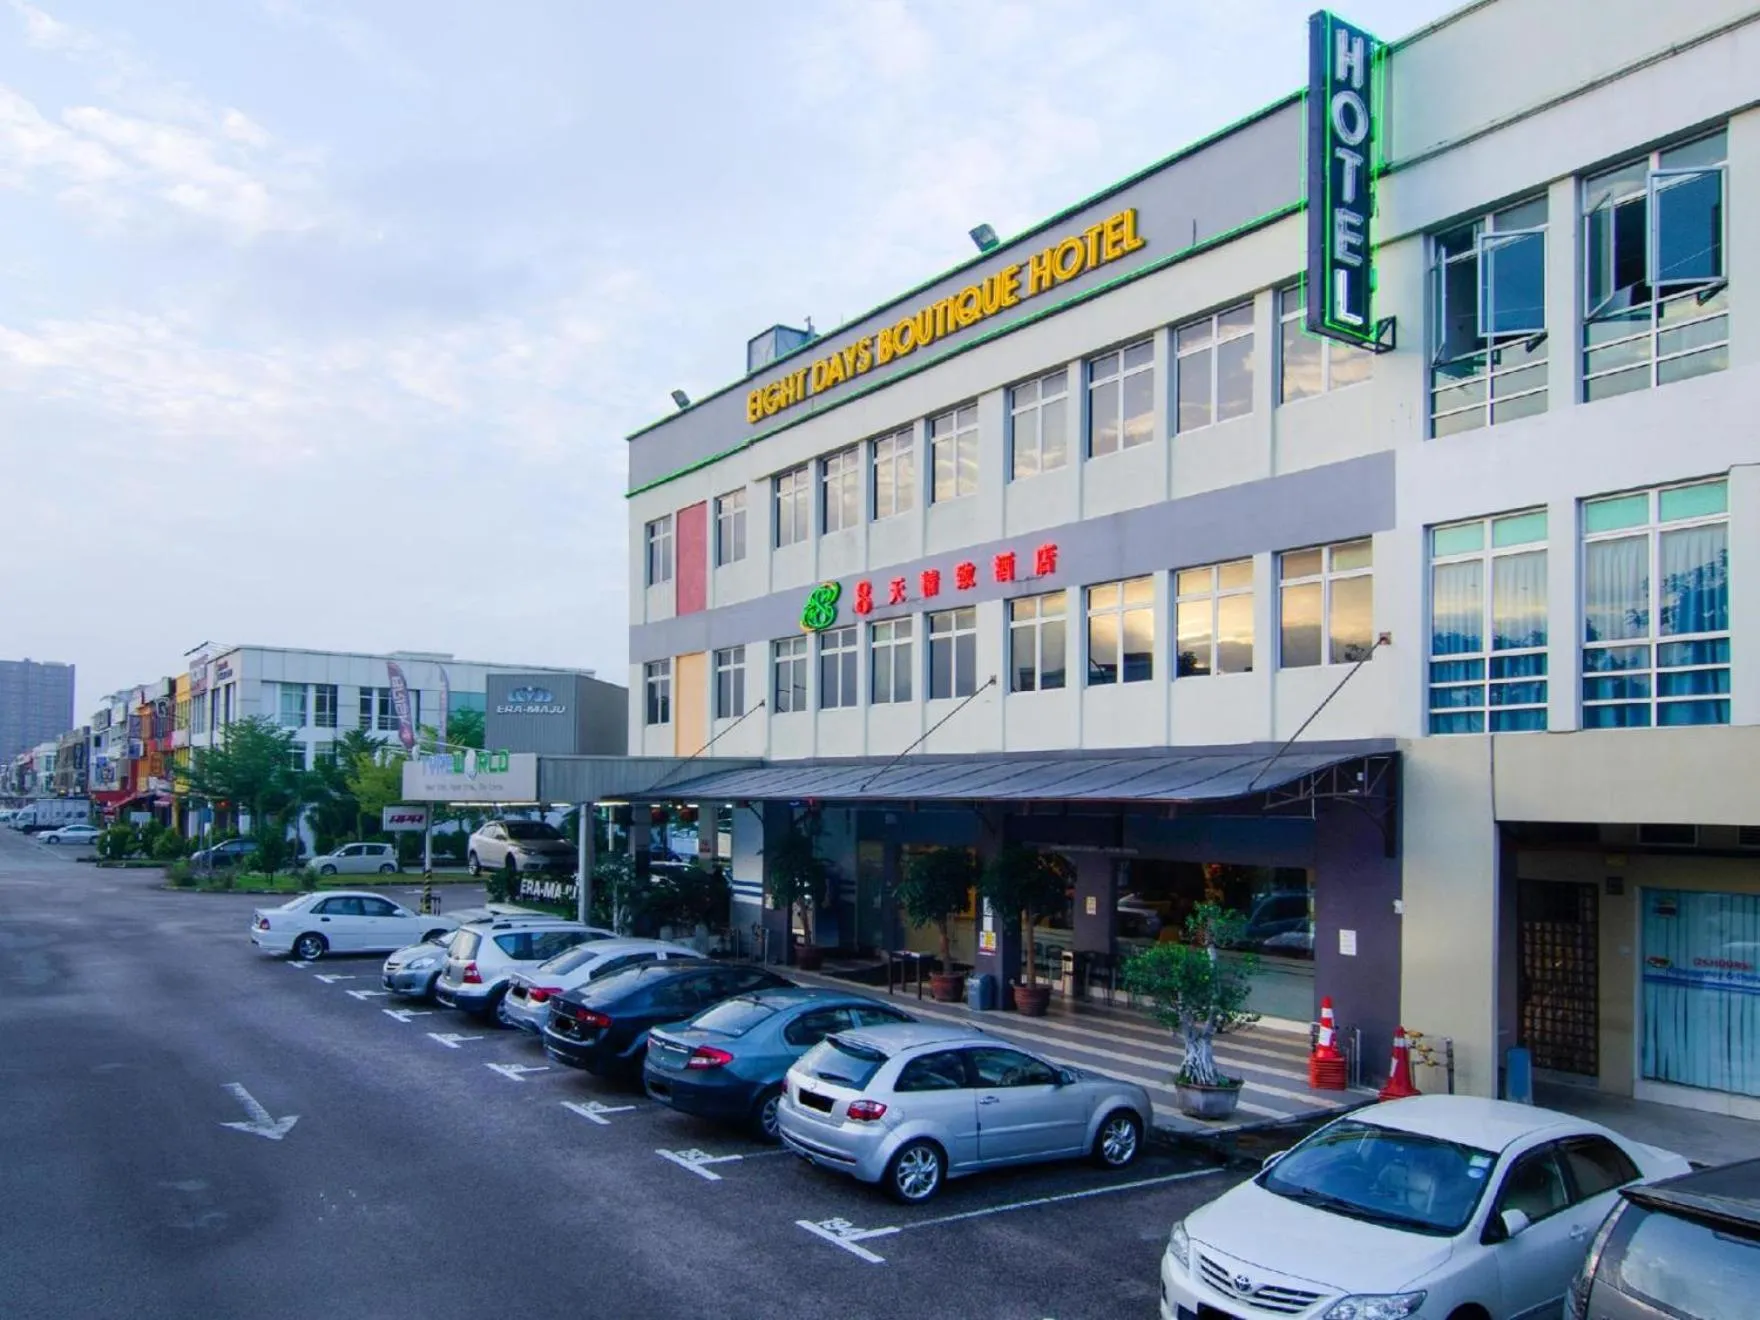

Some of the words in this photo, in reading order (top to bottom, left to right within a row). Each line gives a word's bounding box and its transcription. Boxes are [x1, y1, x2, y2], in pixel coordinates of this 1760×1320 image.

[1331, 28, 1369, 325] HOTEL
[747, 365, 809, 424] EIGHT
[811, 338, 874, 394] DAYS
[878, 263, 1021, 365] BOUTIQUE
[1028, 207, 1147, 295] HOTEL
[497, 704, 567, 714] ERA-MAJU
